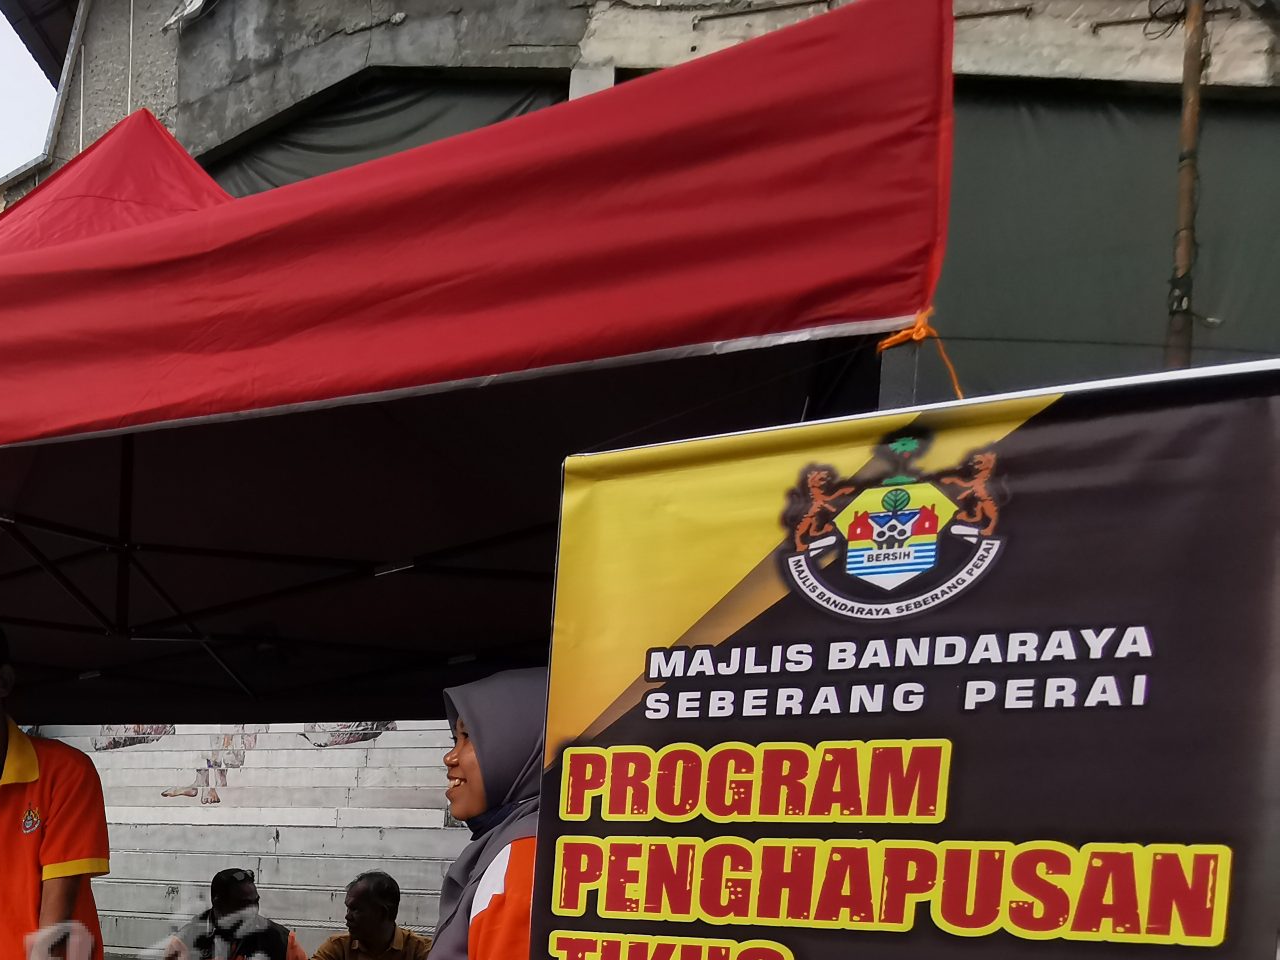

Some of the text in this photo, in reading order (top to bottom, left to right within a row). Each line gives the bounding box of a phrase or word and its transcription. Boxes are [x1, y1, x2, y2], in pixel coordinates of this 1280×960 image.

[791, 541, 996, 617] MAJLIS BANDARAYA SEBERANG PERAI
[866, 551, 912, 563] BERSIH
[648, 626, 1153, 679] MAJLIS BANDARAYA
[644, 674, 1148, 719] SEBERANG PERAI
[560, 740, 951, 823] PROGRAM
[552, 836, 1231, 947] PENGHAPUSAN
